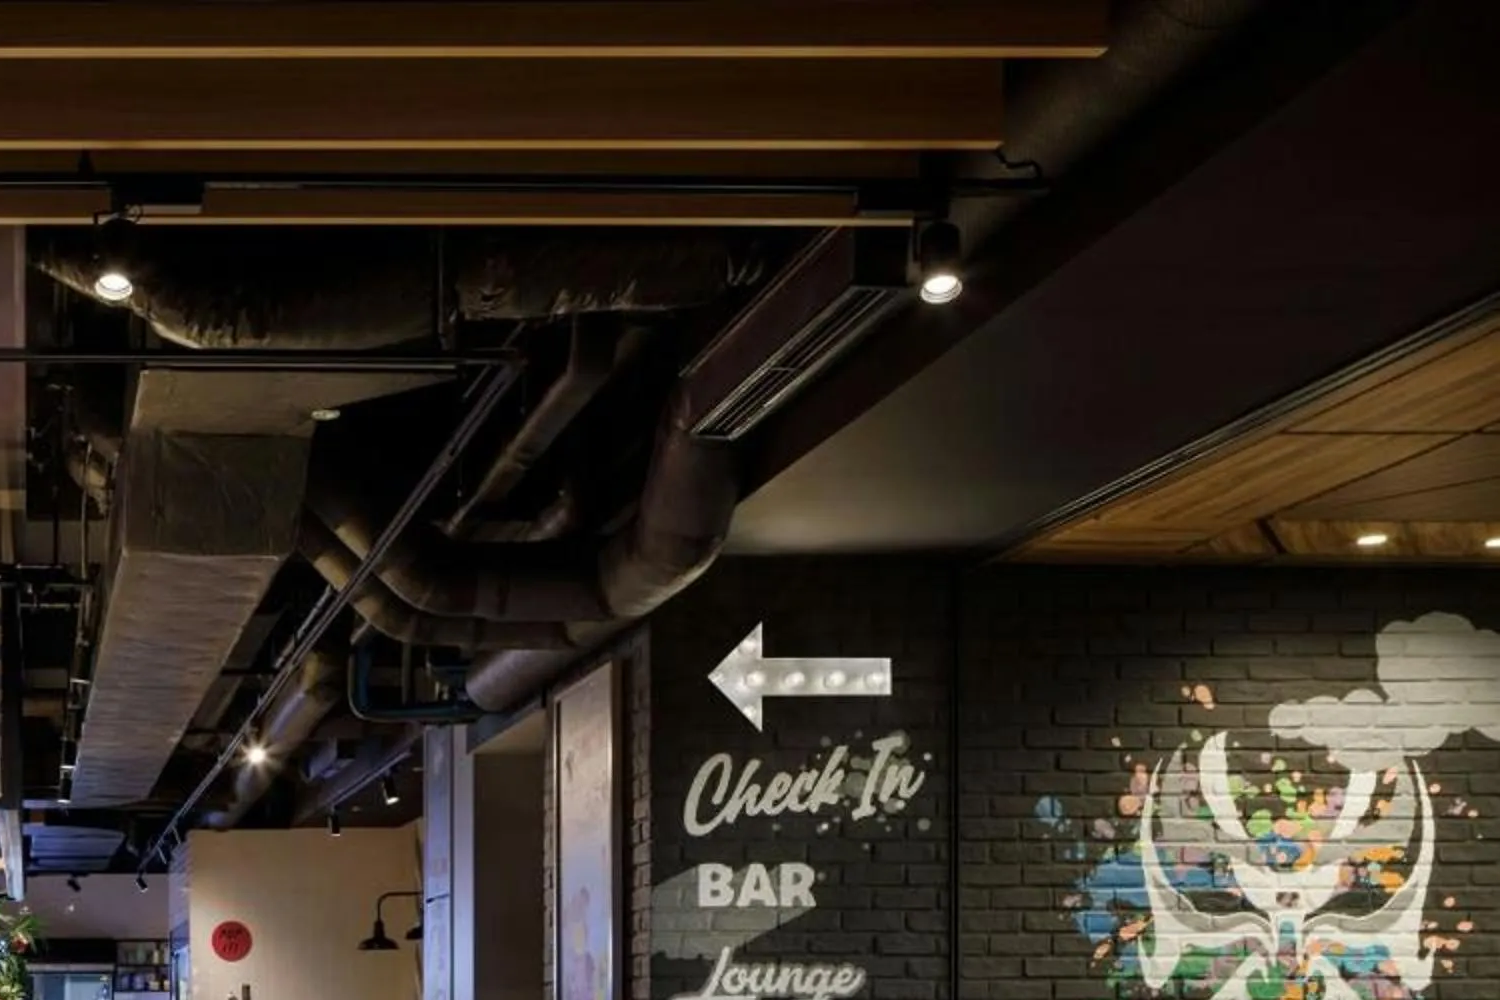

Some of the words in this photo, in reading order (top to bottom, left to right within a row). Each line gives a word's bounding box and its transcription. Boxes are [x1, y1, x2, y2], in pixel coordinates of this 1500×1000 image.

[683, 745, 848, 837] Check
[852, 735, 926, 822] In
[698, 862, 817, 908] BAR
